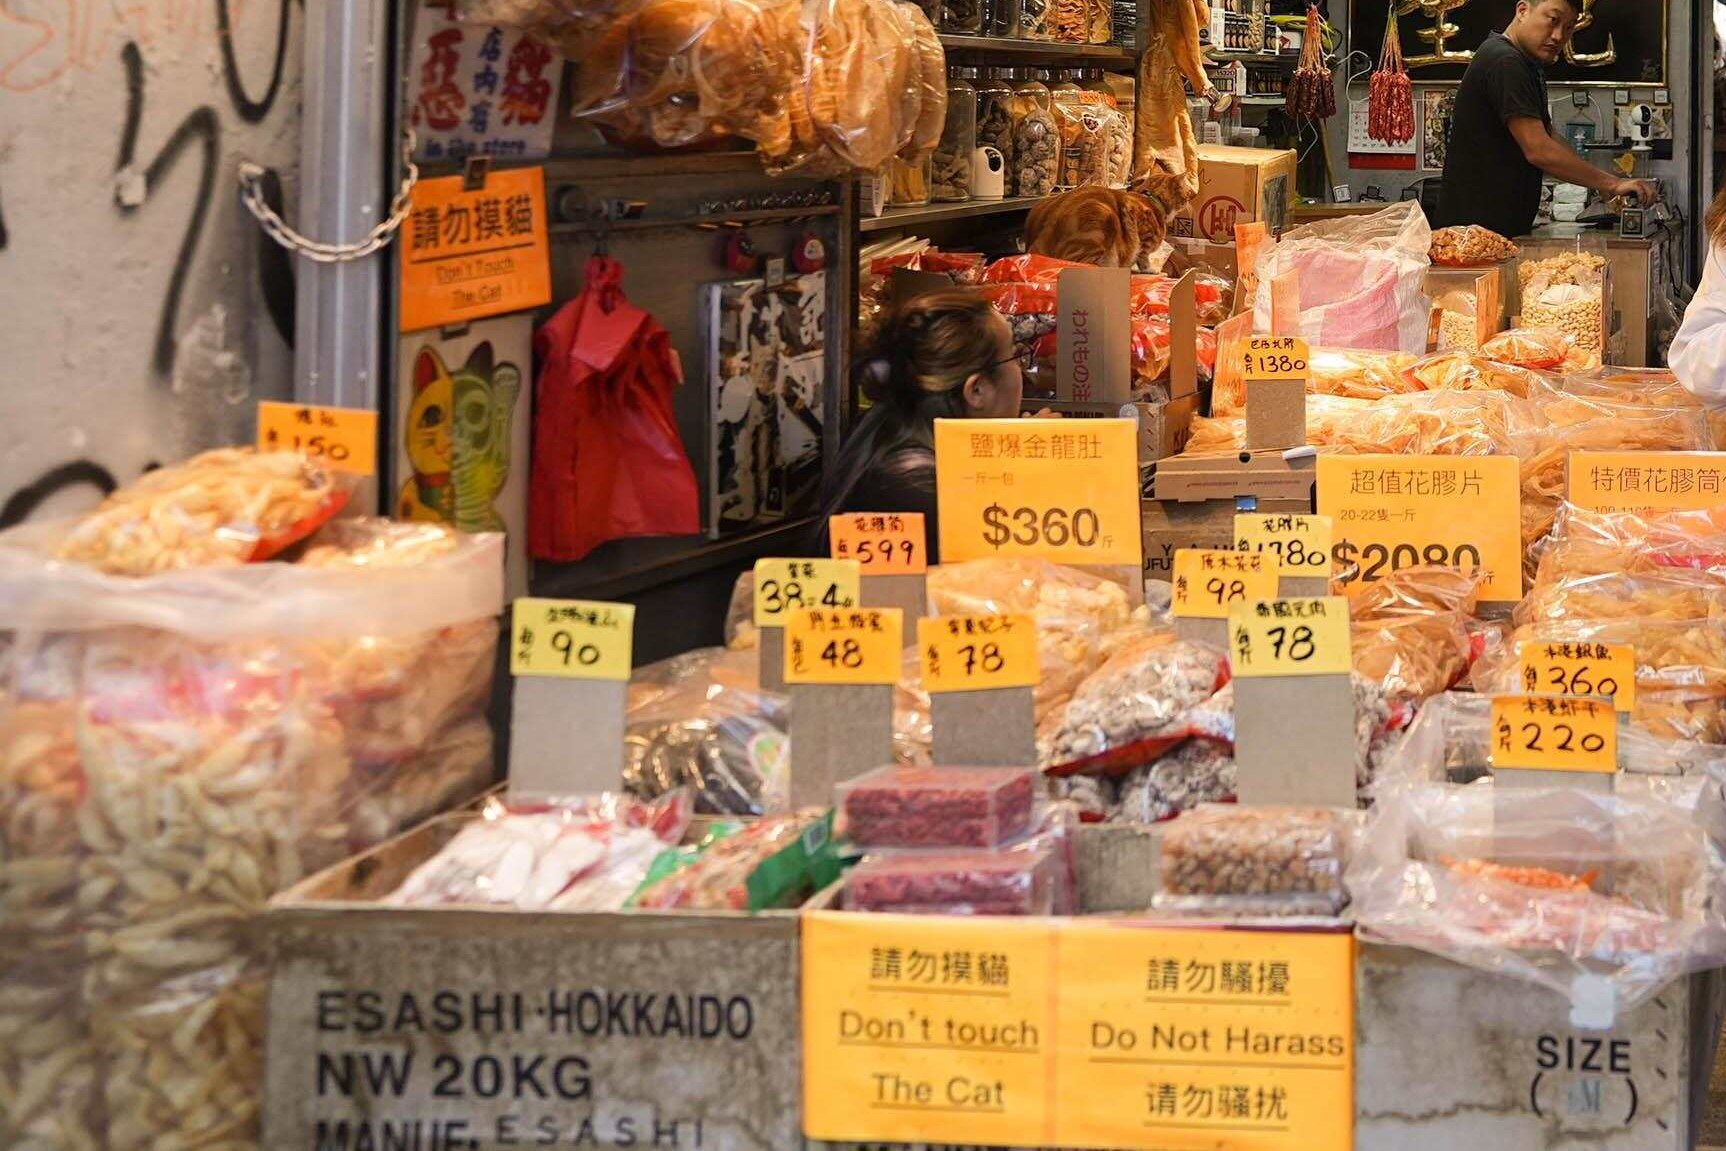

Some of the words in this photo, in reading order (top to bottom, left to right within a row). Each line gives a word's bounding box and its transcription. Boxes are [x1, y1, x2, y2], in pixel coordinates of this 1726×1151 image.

[411, 195, 533, 250] 請勿摸貓
[1259, 355, 1306, 372] 1380
[970, 433, 1103, 460] 鹽爆金龍肚
[1350, 469, 1483, 496] 超值花膠片
[982, 502, 1099, 551] $360
[856, 539, 915, 565] 599
[1206, 577, 1246, 605] 98
[551, 630, 600, 665] 90
[821, 638, 864, 669] 48
[957, 642, 1005, 675] 78
[1267, 625, 1315, 661] 78
[1548, 666, 1618, 696] 360
[1522, 722, 1605, 752] 220
[869, 945, 1011, 989] 請勿摸貓
[1146, 958, 1291, 996] 請勿騷擾
[839, 1009, 940, 1045] Don't
[943, 1015, 1039, 1048] touch
[1091, 1023, 1137, 1052] Do
[1151, 1024, 1210, 1055] Not
[1225, 1026, 1345, 1058] Harass
[1536, 1036, 1632, 1074] SIZE
[317, 1055, 415, 1098] NW
[433, 1055, 592, 1101] 20KG
[871, 1074, 941, 1105] The
[947, 1076, 1005, 1110] Cat
[1144, 1083, 1289, 1120] 请勿骚扰
